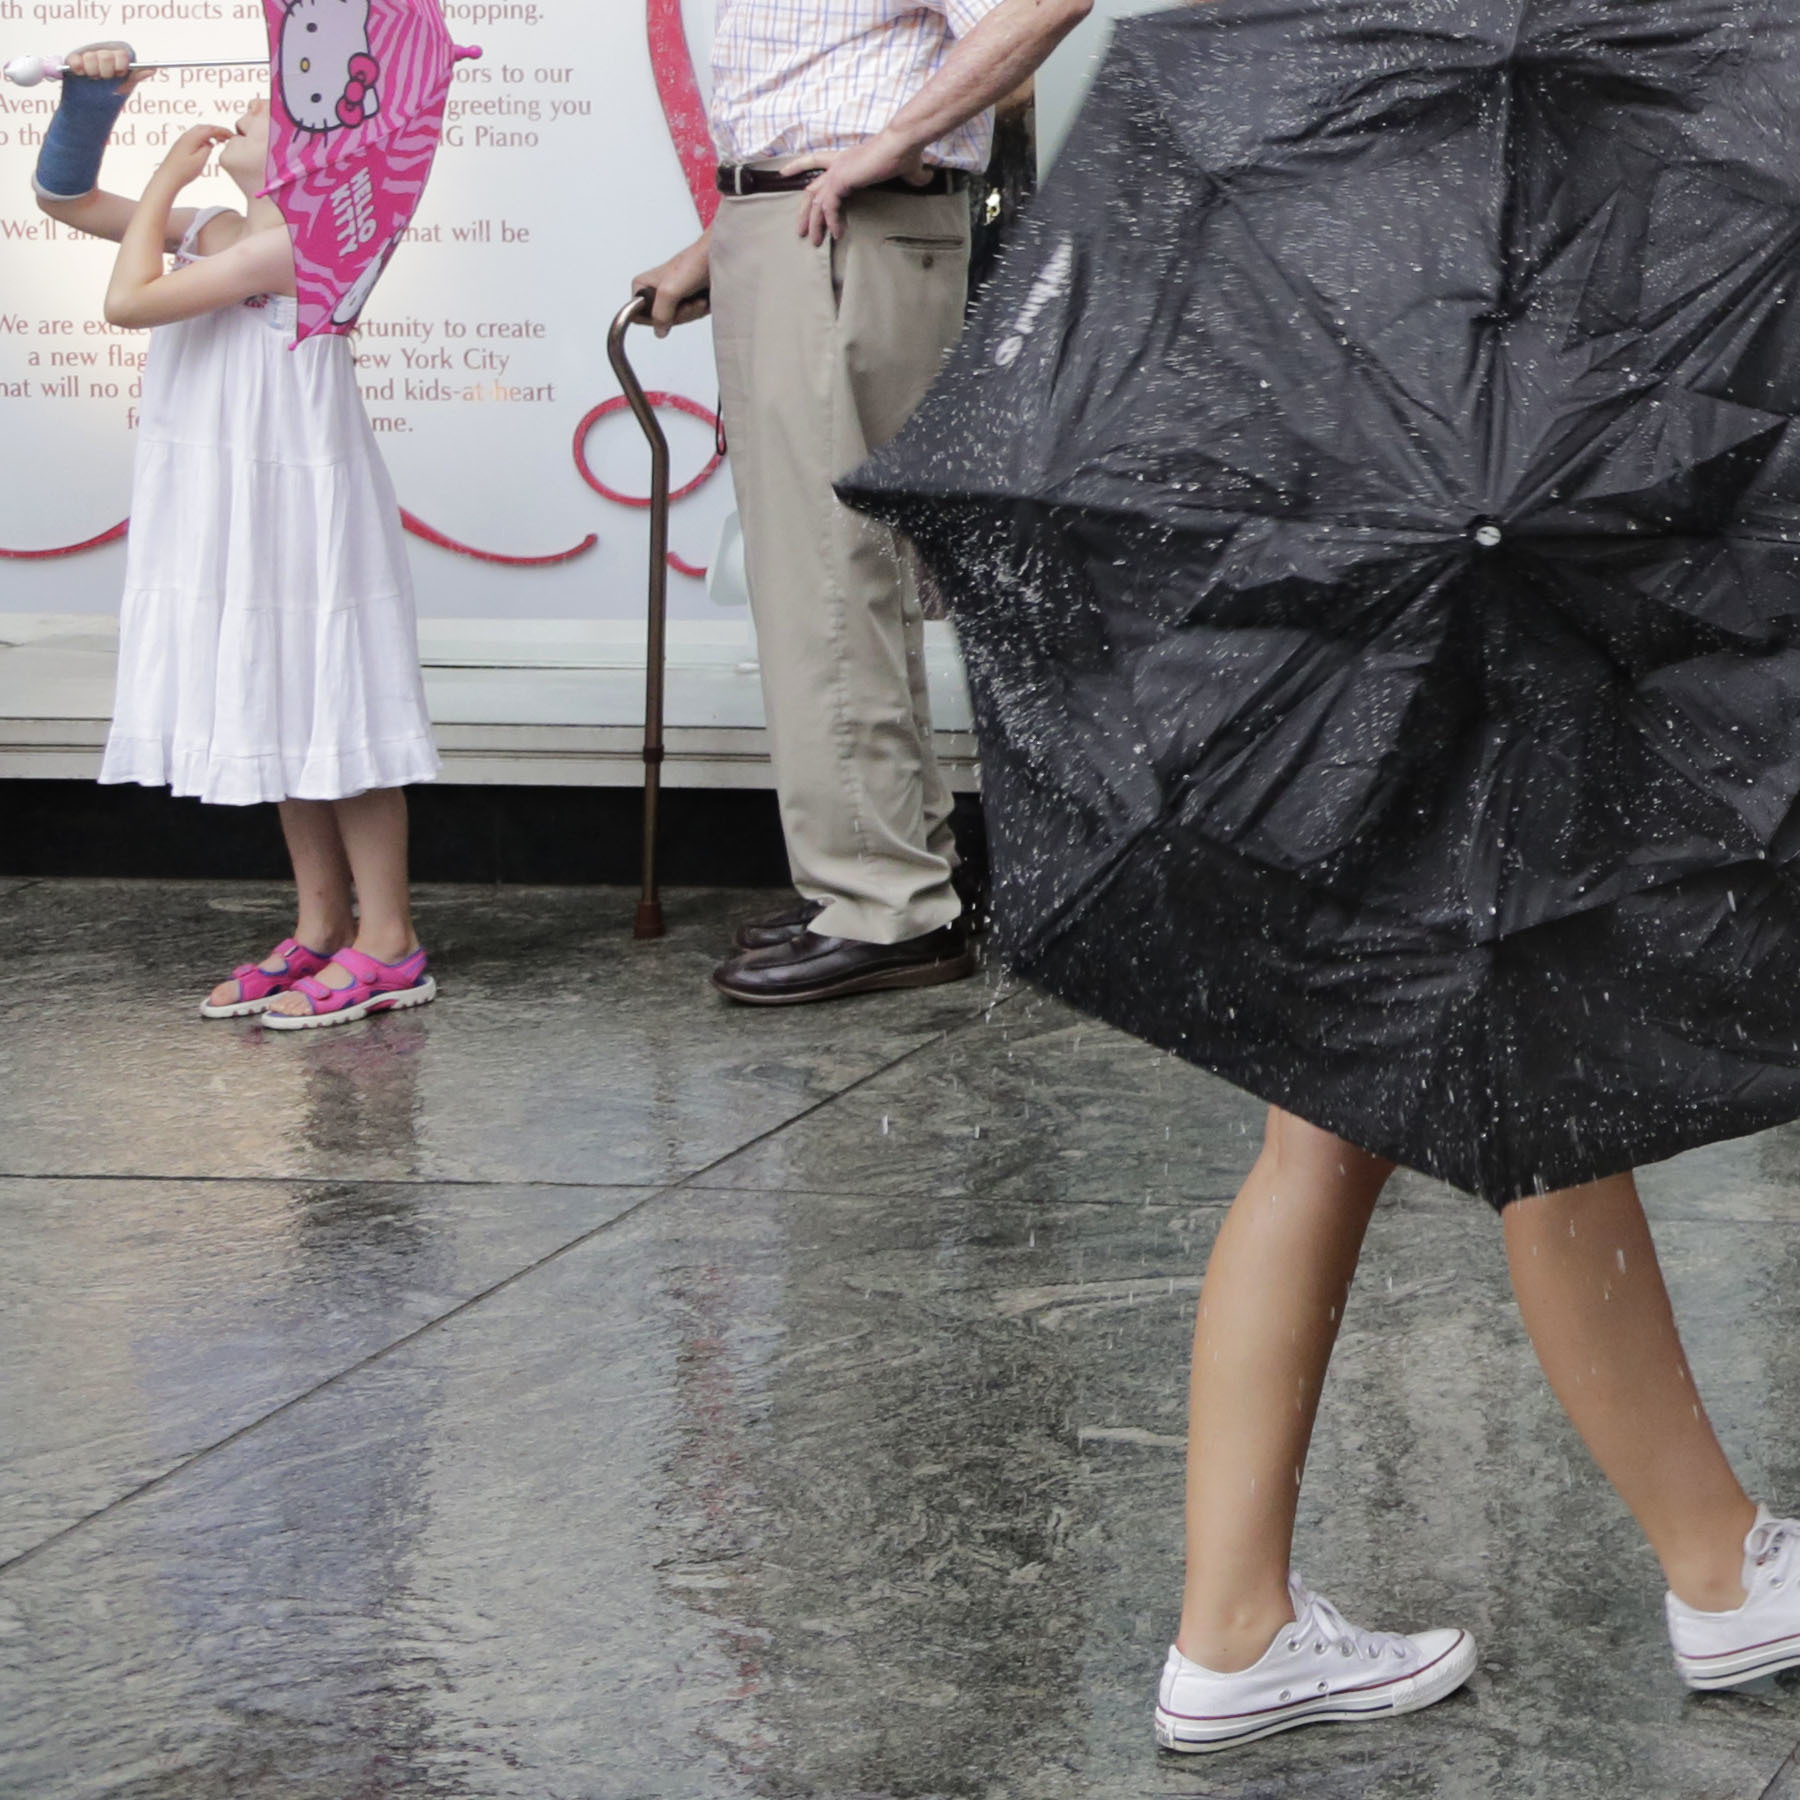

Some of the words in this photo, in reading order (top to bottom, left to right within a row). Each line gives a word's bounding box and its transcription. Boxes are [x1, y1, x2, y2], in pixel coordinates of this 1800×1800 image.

[502, 64, 524, 83] to
[534, 66, 573, 83] our
[448, 94, 541, 120] greeting
[551, 101, 591, 120] you
[146, 123, 169, 146] of
[475, 126, 539, 147] Piano
[350, 166, 377, 243] HELLO
[330, 183, 358, 257] KITTY
[452, 220, 490, 242] will
[501, 220, 529, 242] be
[38, 319, 73, 334] are
[445, 319, 466, 338] to
[476, 318, 545, 338] create
[28, 351, 40, 366] a
[51, 351, 97, 366] new
[402, 347, 452, 369] York
[463, 347, 510, 375] City
[41, 376, 79, 397] will
[90, 382, 118, 397] no
